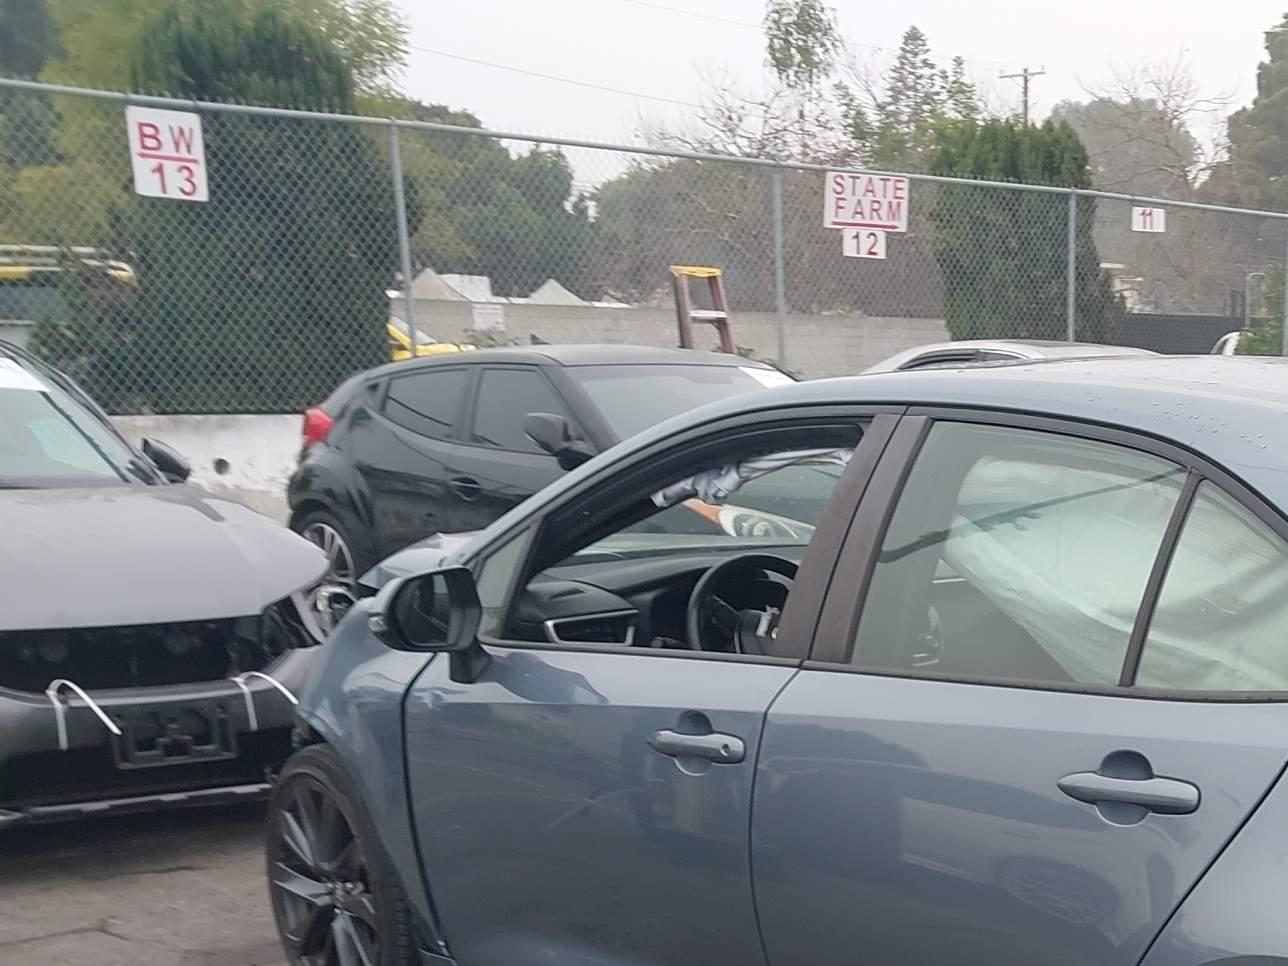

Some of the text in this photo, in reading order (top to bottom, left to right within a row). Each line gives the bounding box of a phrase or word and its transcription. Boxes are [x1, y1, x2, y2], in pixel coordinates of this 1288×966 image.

[137, 121, 194, 155] BW
[150, 162, 197, 197] 13
[832, 173, 905, 200] STATE
[834, 197, 902, 222] FARM
[1139, 208, 1153, 231] 11
[851, 231, 878, 256] 12
